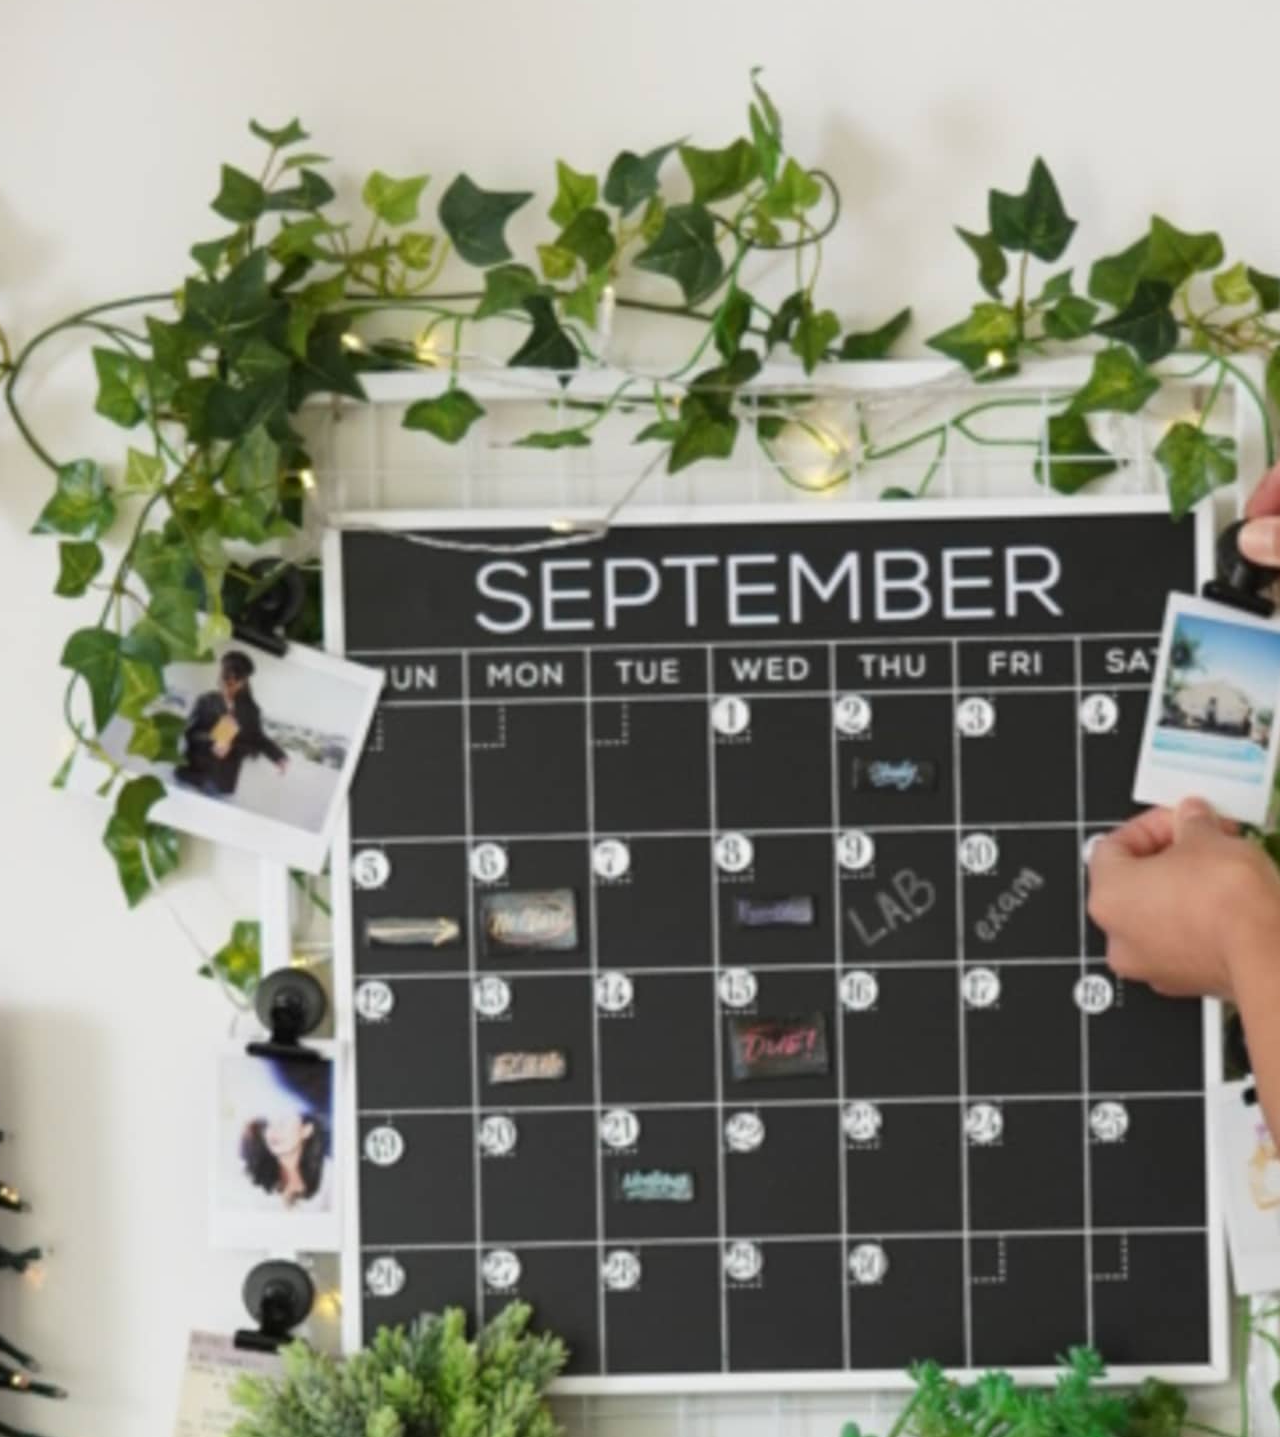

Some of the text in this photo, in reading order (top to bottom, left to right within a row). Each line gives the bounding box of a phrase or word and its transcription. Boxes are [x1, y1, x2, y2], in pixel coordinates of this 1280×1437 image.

[474, 546, 1063, 633] SEPTEMBER
[384, 665, 438, 691] UN
[487, 662, 563, 687] MON
[615, 659, 678, 685] TUE
[731, 656, 809, 681] WED
[860, 654, 926, 678] THU
[989, 651, 1041, 675] FRI
[843, 700, 861, 730] 2
[966, 703, 985, 730] 3
[1090, 698, 1108, 727] 4
[361, 835, 993, 883] 5 6 7 8 9 10
[846, 866, 1046, 946] LAB exam
[362, 974, 1107, 1014] 12 13 14 15 16 17 18
[609, 1115, 631, 1142] 21
